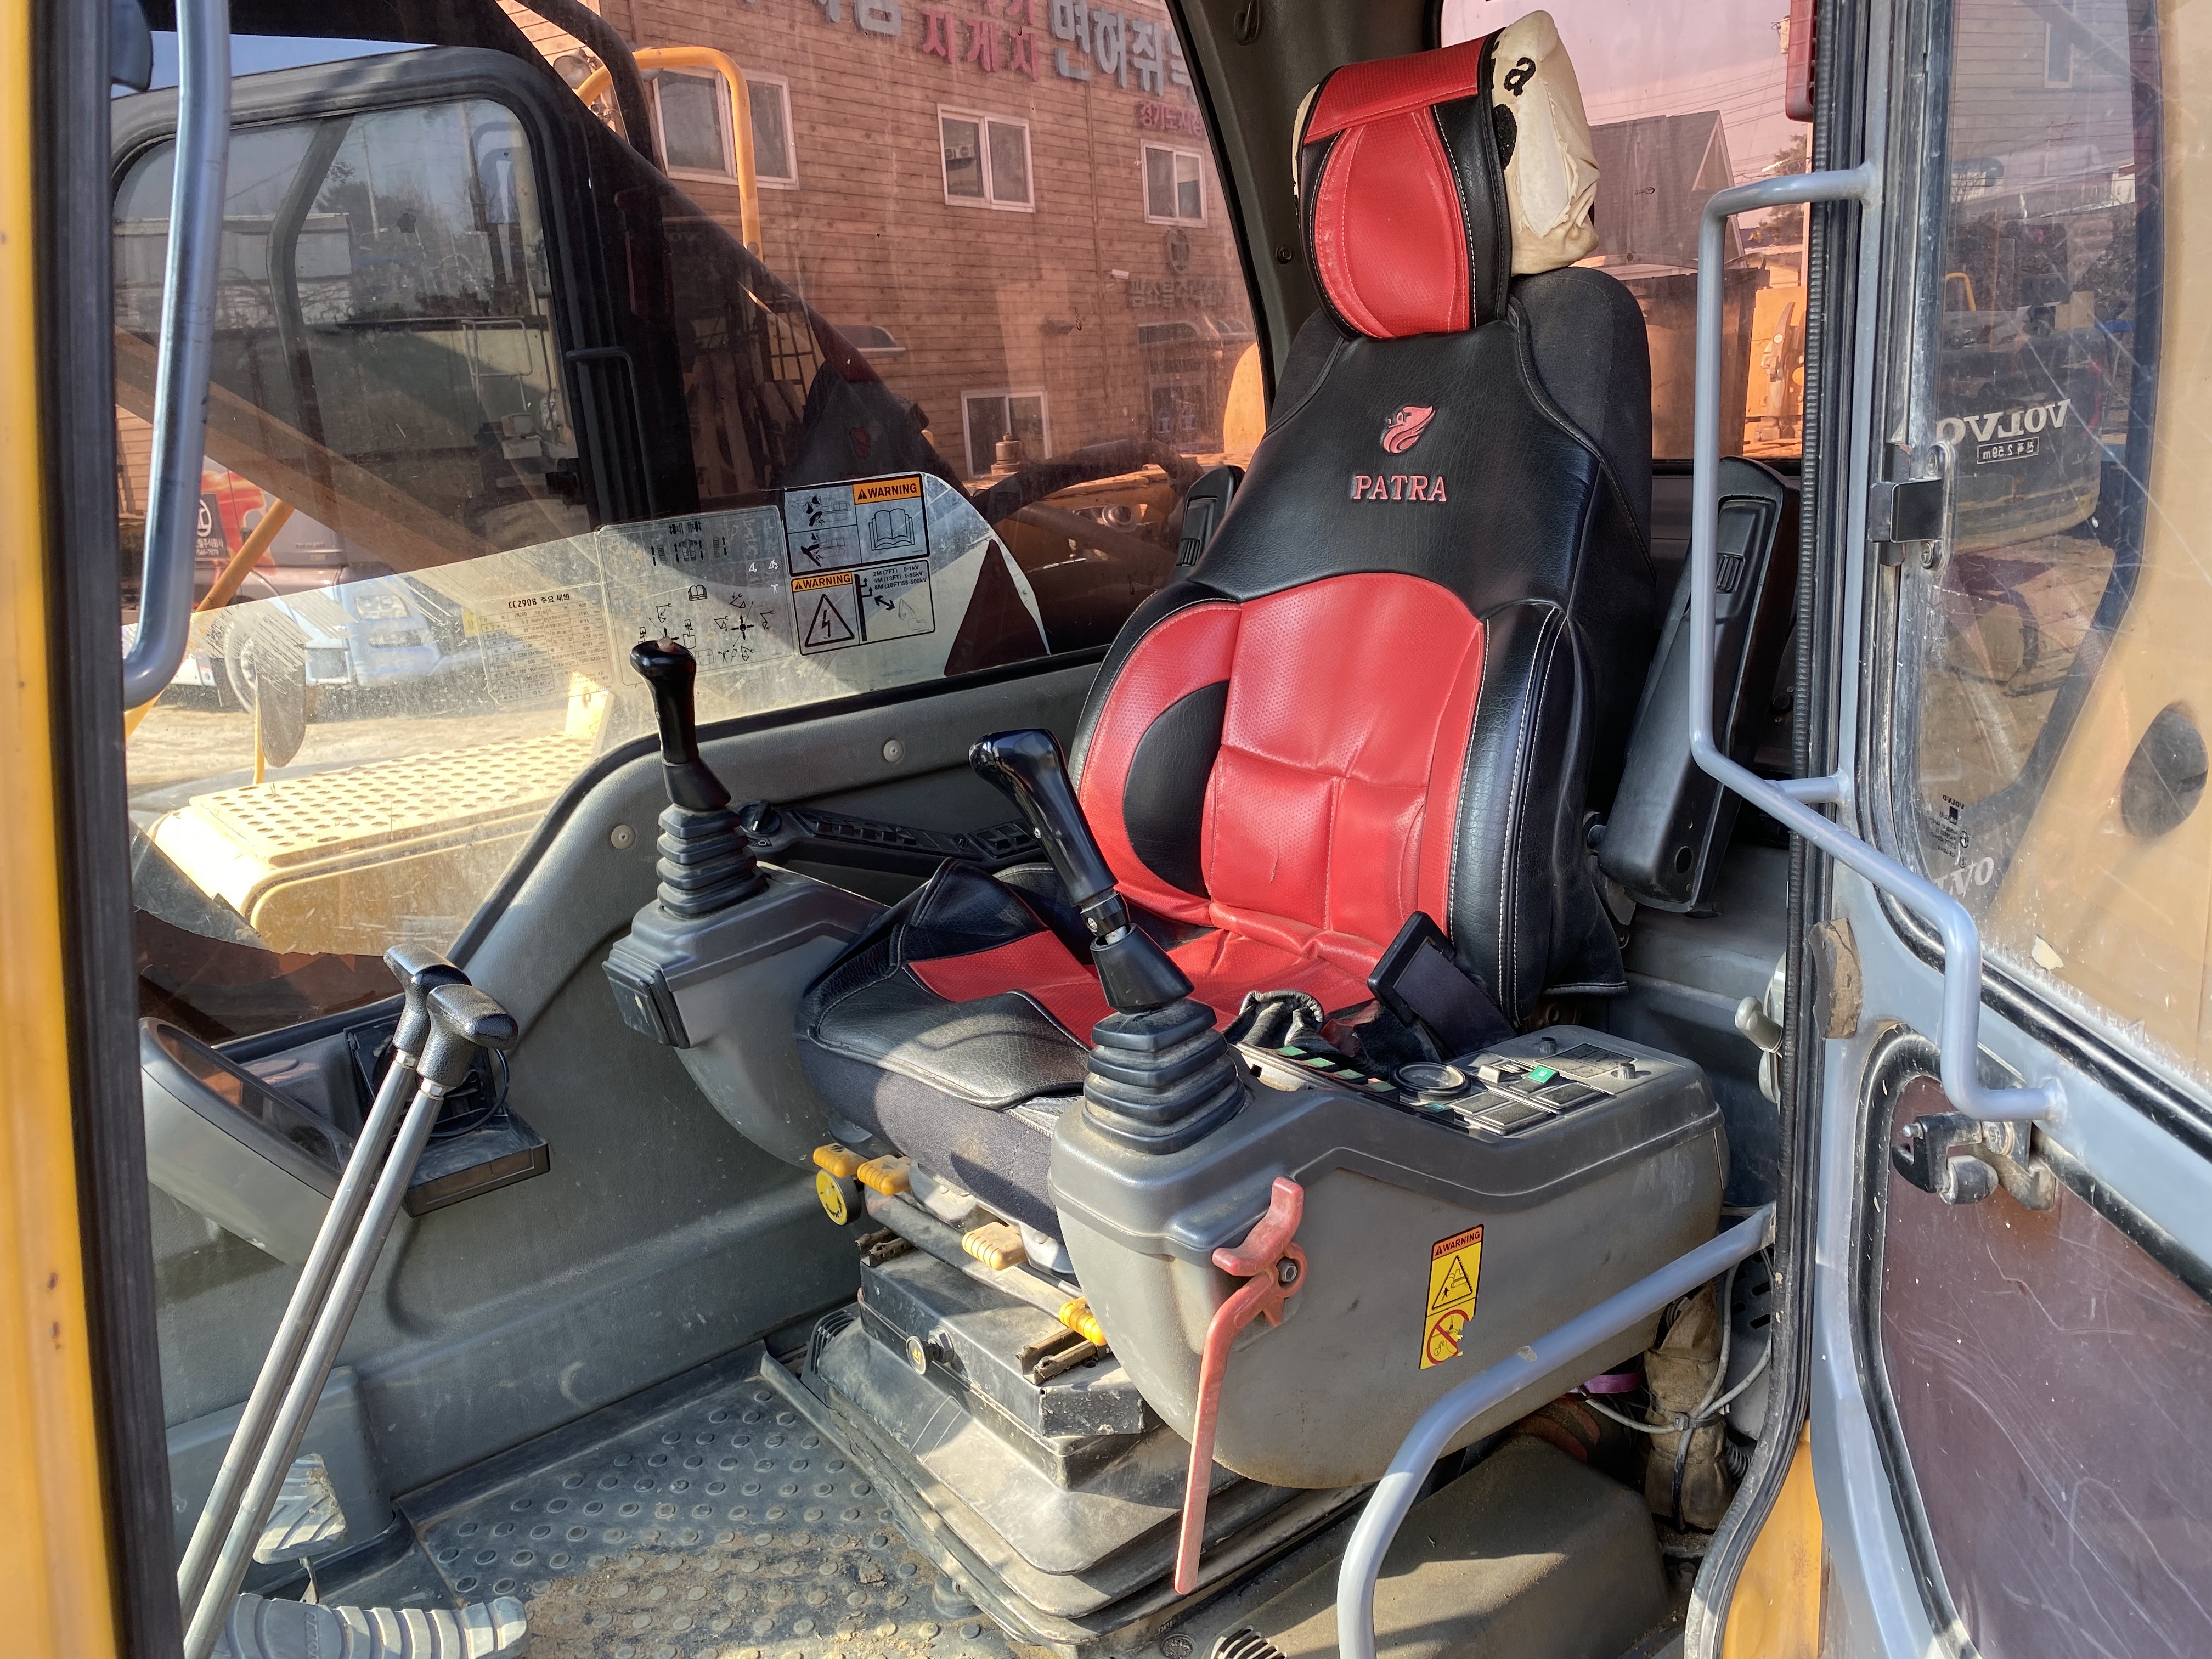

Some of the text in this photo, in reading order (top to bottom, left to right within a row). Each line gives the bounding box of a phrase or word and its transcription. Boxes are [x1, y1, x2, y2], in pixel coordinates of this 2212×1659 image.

[867, 483, 917, 498] WARNING
[1353, 475, 1447, 502] PATRA
[883, 568, 898, 576] (7FT)
[884, 574, 901, 583] (13FT)
[803, 574, 850, 588] WARNING
[508, 592, 569, 608] EC290B 주요 제원
[1443, 1231, 1480, 1252] WARNING
